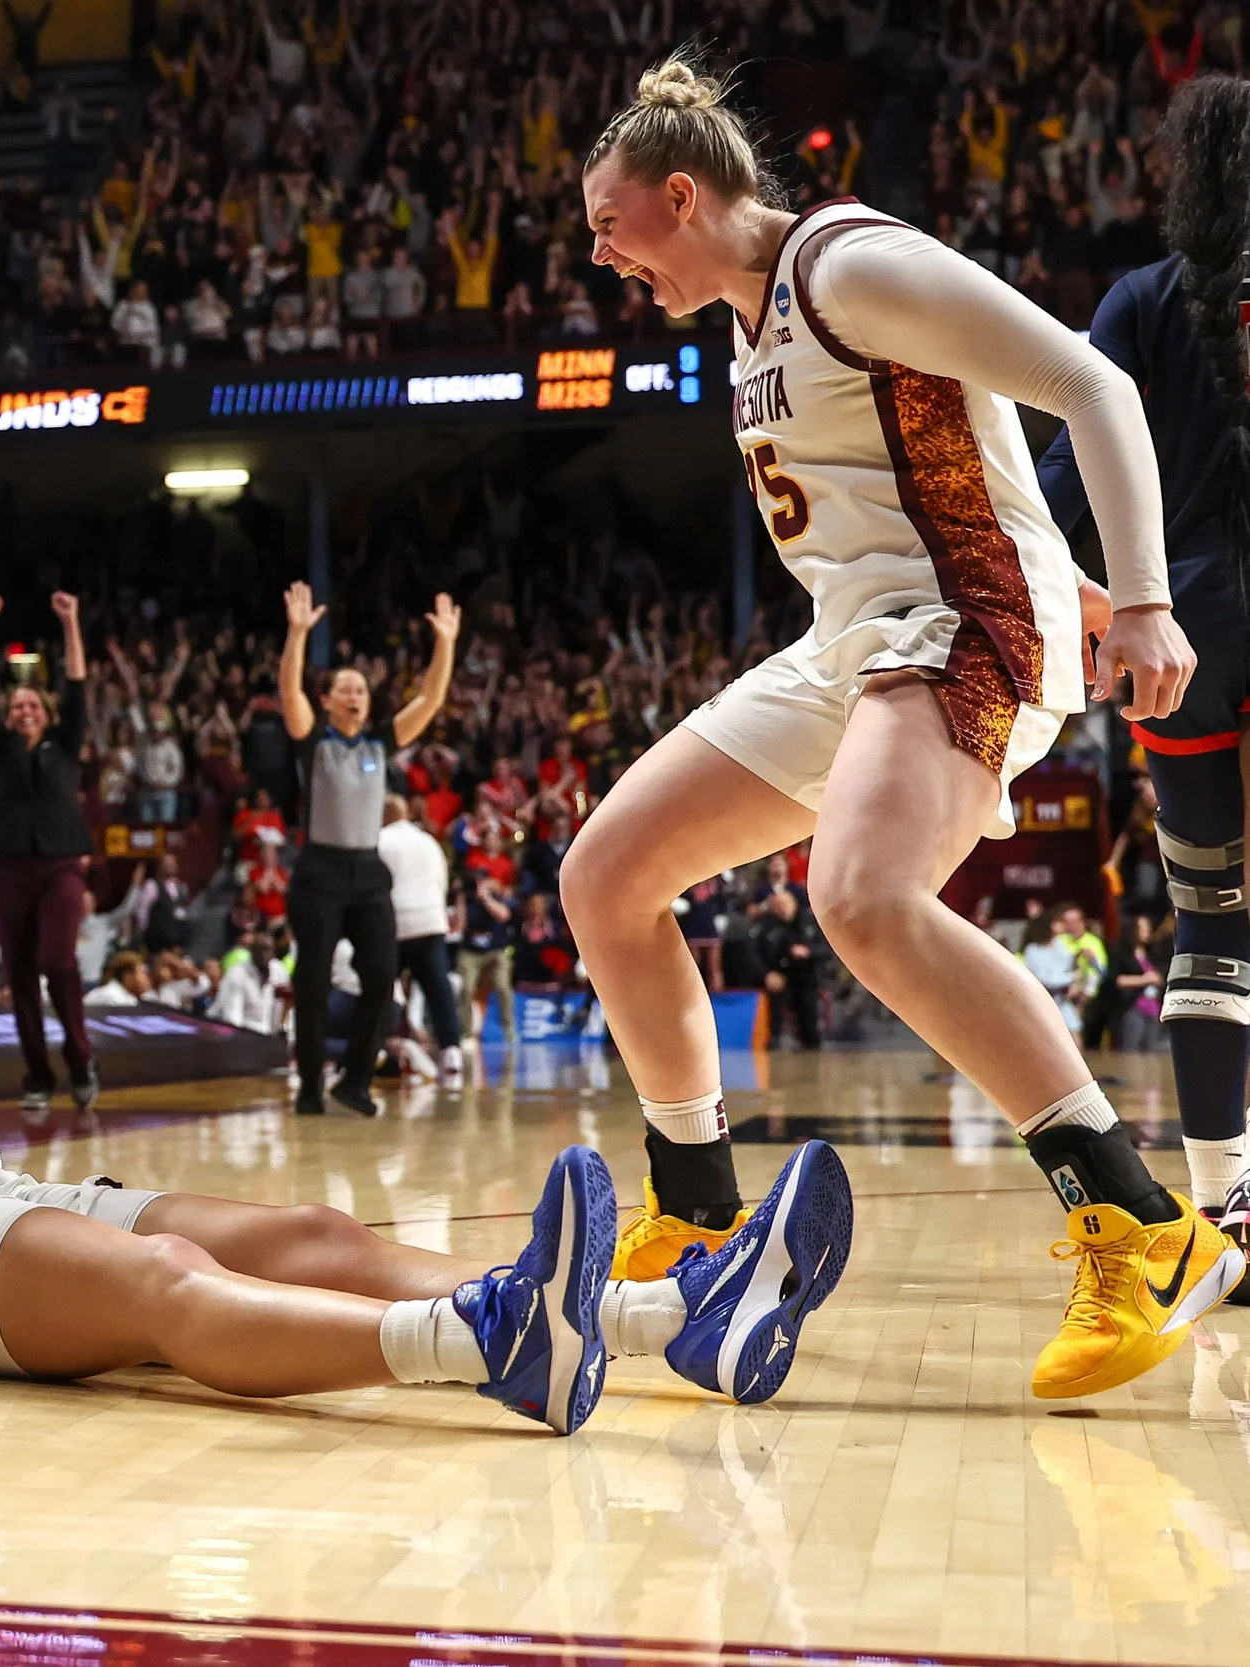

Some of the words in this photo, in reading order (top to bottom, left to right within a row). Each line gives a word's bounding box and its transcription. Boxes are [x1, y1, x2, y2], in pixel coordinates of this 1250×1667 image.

[537, 348, 616, 379] MINN
[536, 379, 614, 411] MISS
[744, 440, 811, 546] 5
